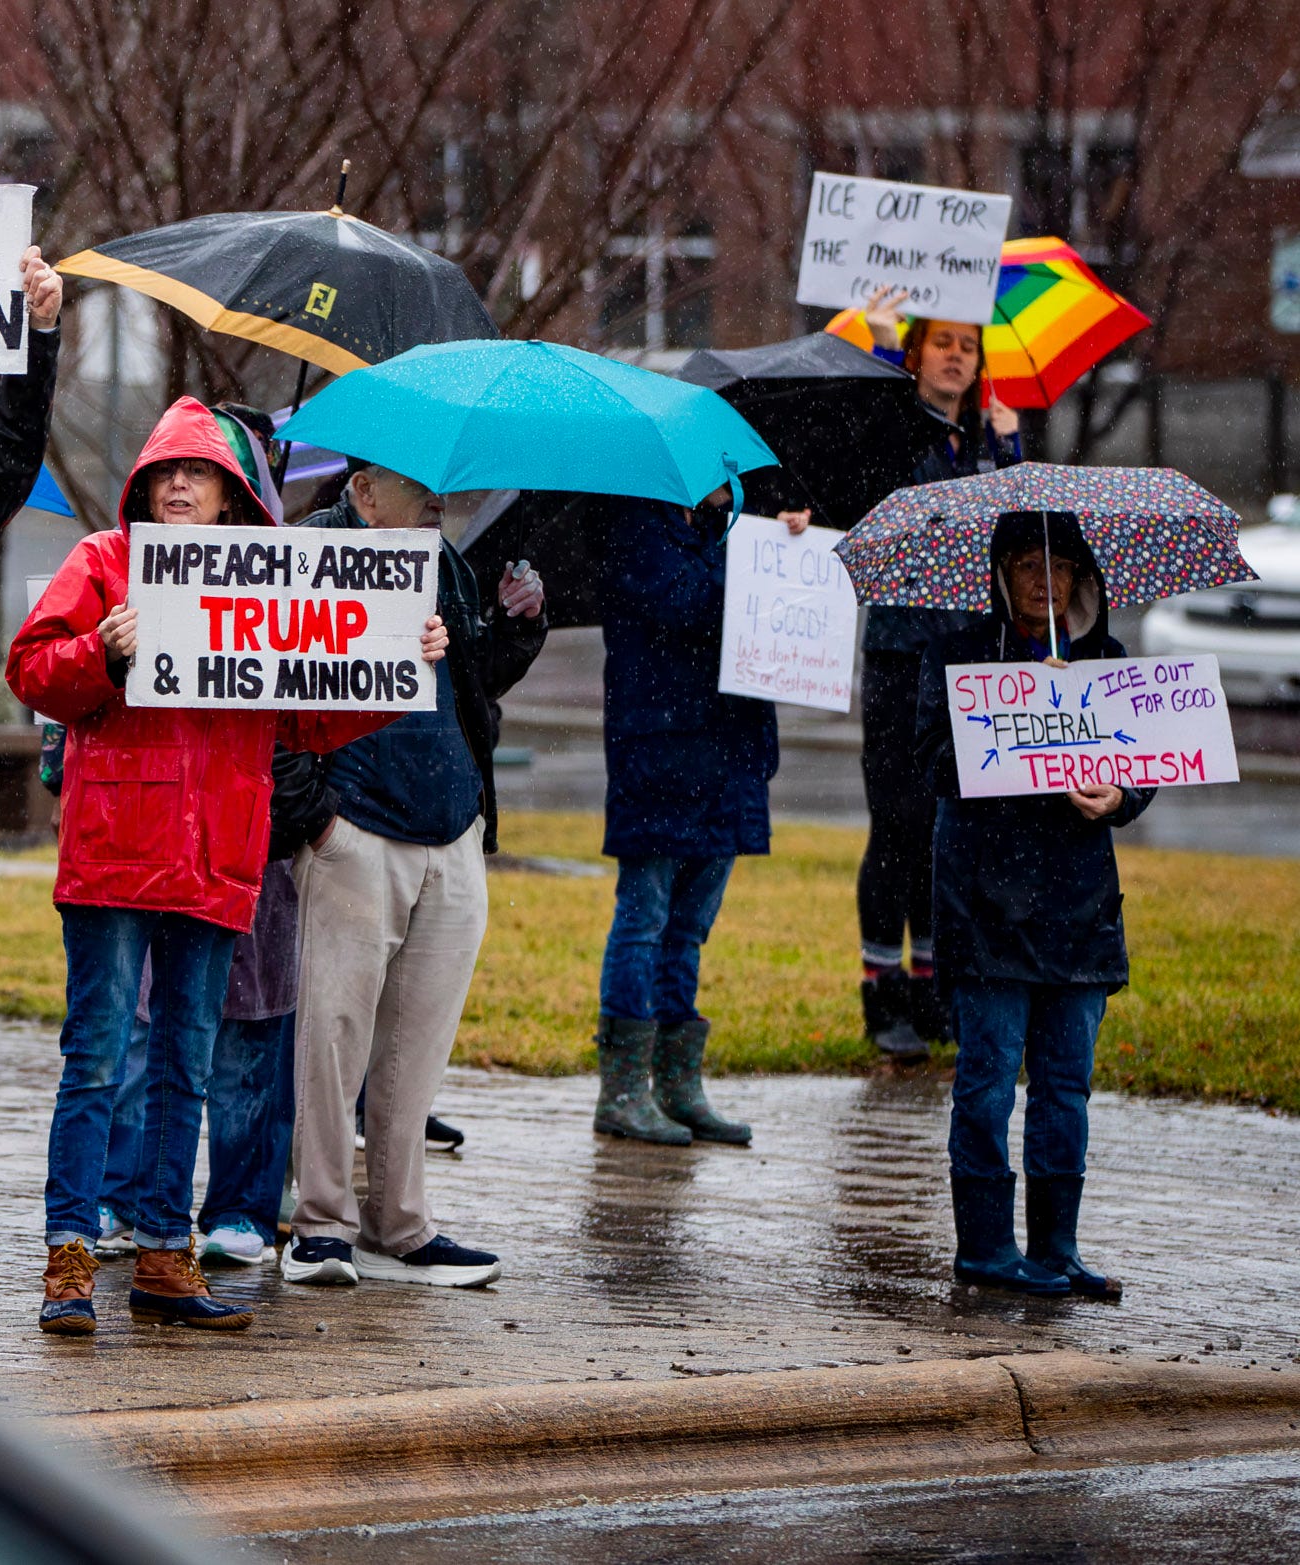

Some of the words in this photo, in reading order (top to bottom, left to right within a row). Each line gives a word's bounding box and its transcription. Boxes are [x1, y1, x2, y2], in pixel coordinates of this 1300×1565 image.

[818, 182, 856, 220] ICE
[876, 190, 925, 221] OUT
[937, 195, 987, 231] FOR
[808, 239, 849, 266] THE
[866, 242, 926, 270] MALIK
[935, 246, 997, 286] FAMILY
[142, 543, 292, 587] IMPEACH
[298, 552, 309, 575] &
[311, 545, 430, 593] ARREST
[753, 539, 787, 579] ICE
[800, 548, 842, 590] OUT
[200, 595, 369, 655] TRUMP
[746, 593, 760, 635] 4
[770, 597, 828, 639] GOOD!
[737, 635, 760, 660] We
[154, 653, 181, 696] &
[198, 656, 264, 700] HIS
[274, 658, 419, 702] MINIONS
[956, 671, 1036, 712] STOP
[1098, 666, 1147, 698] ICE
[1154, 663, 1195, 684] OUT
[1131, 692, 1166, 717] FOR
[1172, 687, 1216, 712] GOOD
[992, 712, 1112, 747] FEDERAL
[1020, 749, 1207, 790] TERRORISM
